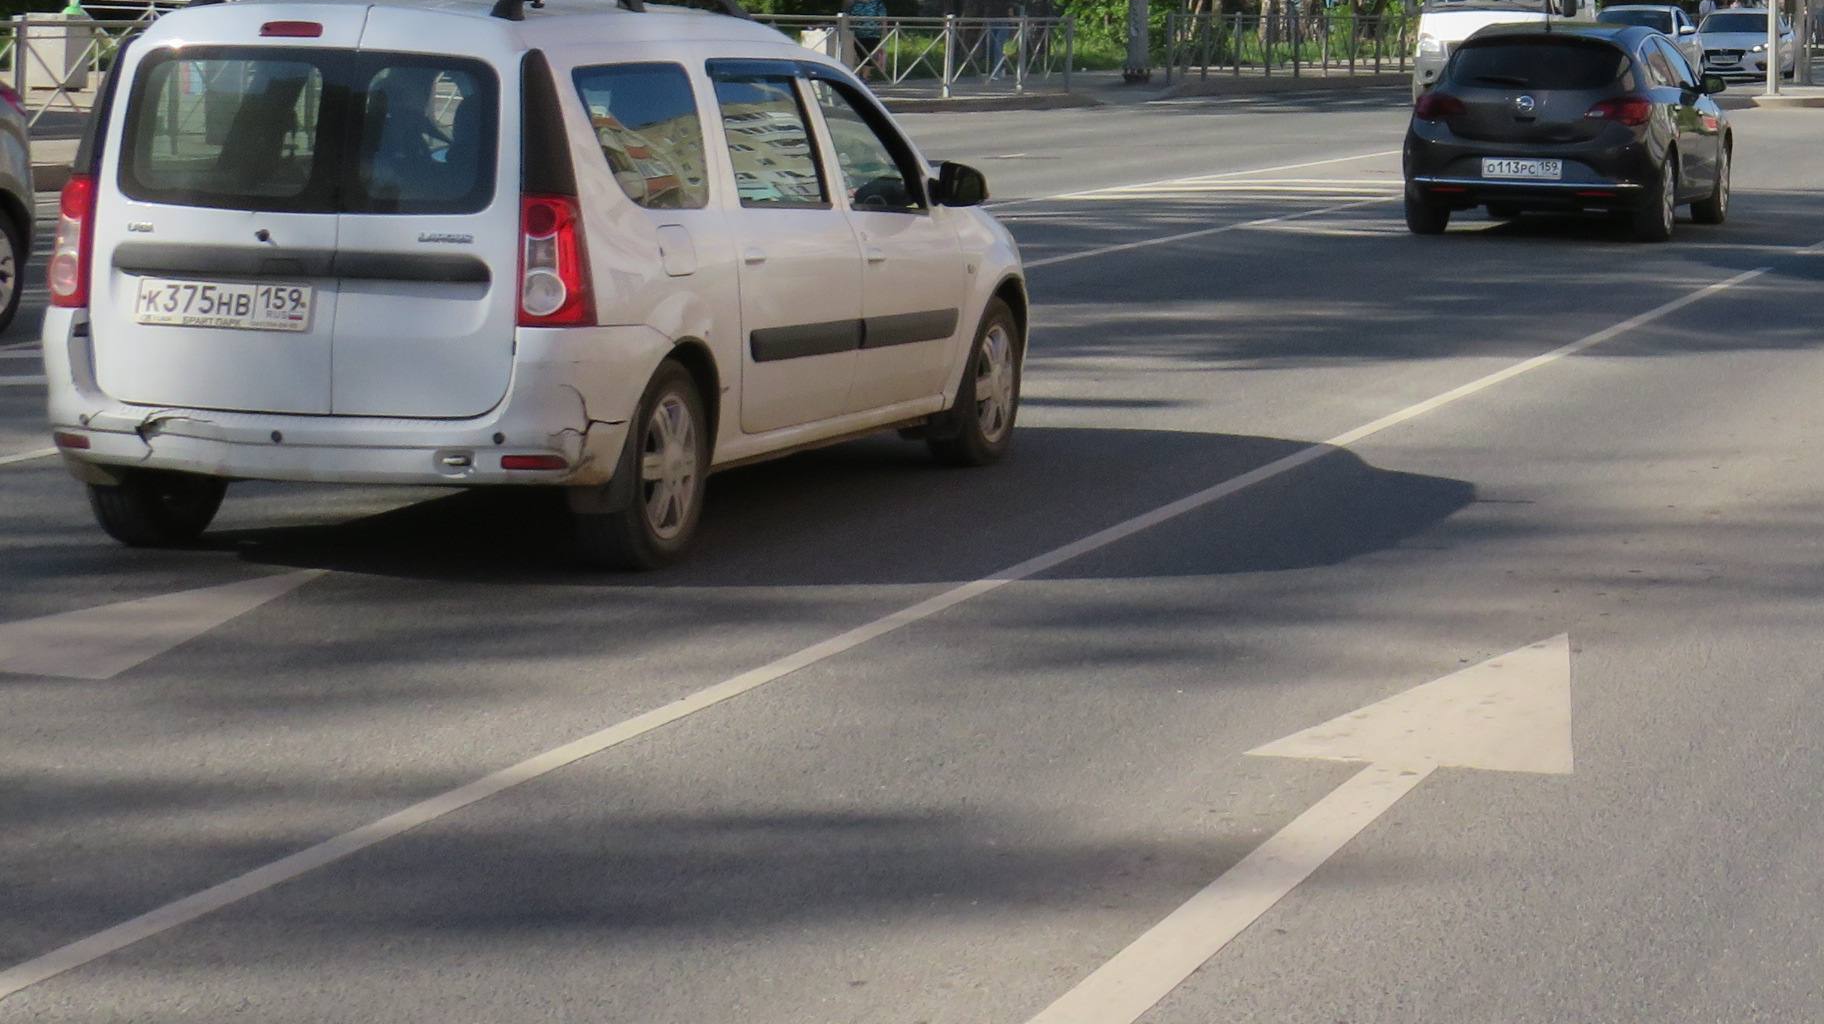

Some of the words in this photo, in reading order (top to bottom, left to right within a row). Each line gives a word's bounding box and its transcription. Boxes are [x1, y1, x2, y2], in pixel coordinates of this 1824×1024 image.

[1539, 161, 1558, 172] 159
[260, 287, 303, 311] 159
[266, 310, 287, 320] RUS
